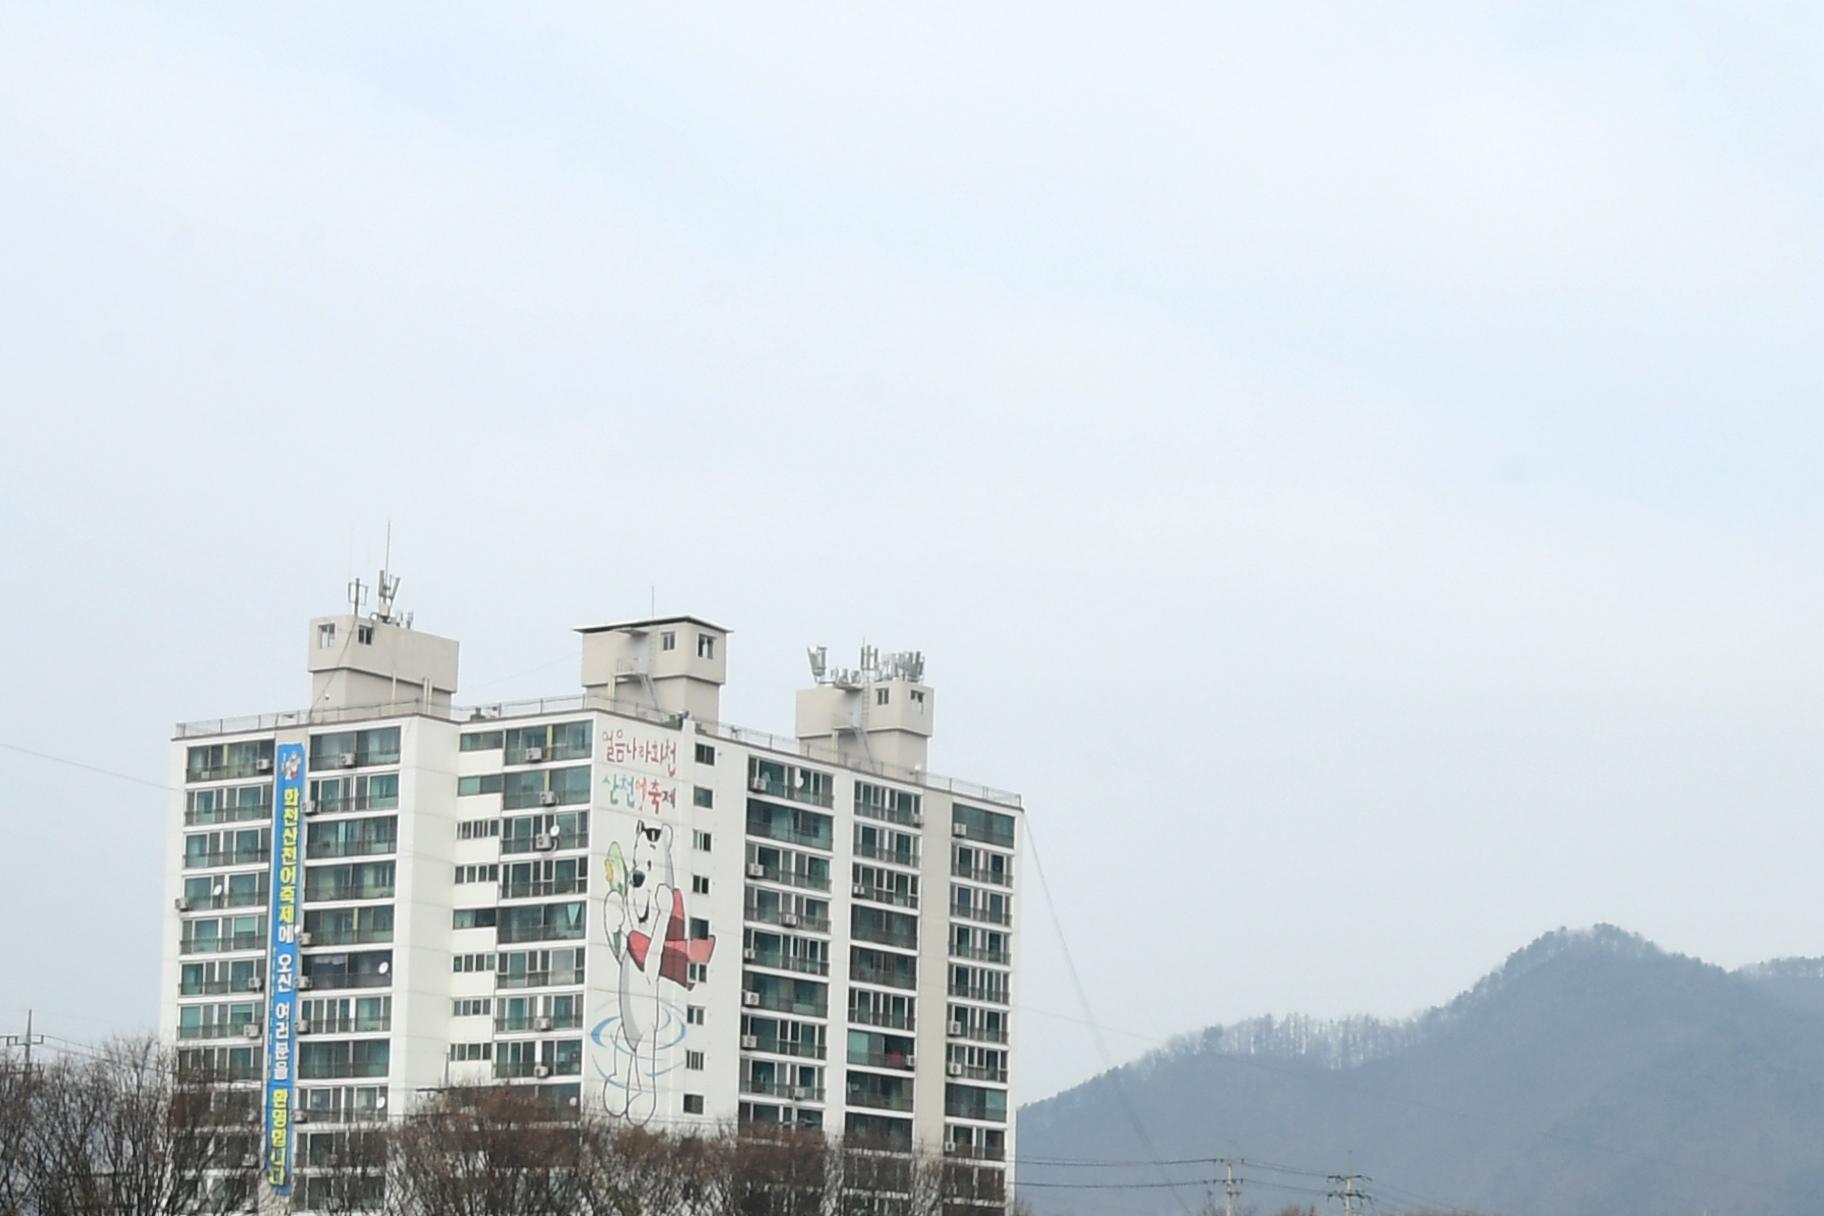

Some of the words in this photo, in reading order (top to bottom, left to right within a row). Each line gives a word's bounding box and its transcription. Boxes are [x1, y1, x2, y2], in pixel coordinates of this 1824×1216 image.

[277, 787, 298, 944] 화천산천어축제에
[277, 953, 292, 993] 오신
[273, 1002, 290, 1081] 여러분을
